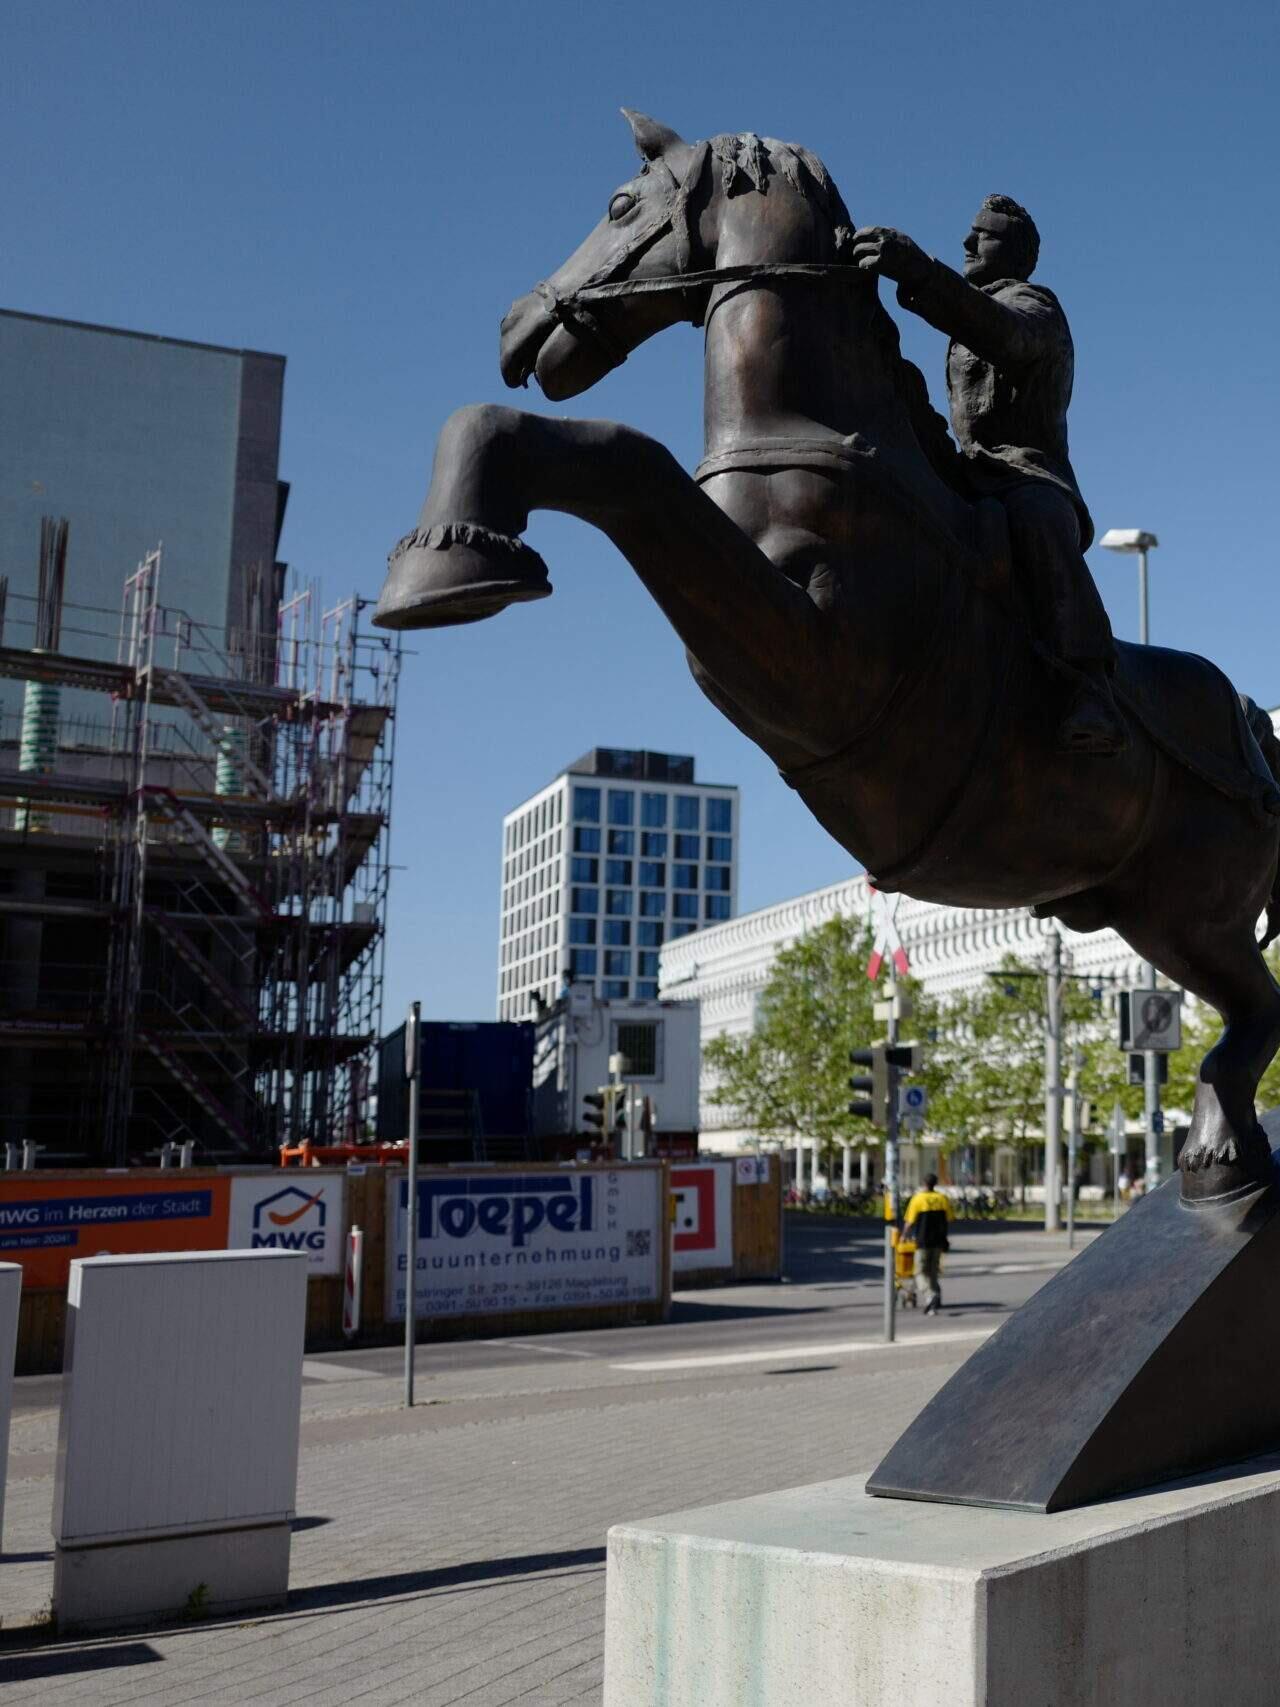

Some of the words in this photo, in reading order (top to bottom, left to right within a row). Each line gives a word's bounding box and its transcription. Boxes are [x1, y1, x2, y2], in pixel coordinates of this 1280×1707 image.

[44, 1207, 64, 1222] im
[68, 1204, 128, 1221] Herzen
[131, 1200, 157, 1217] der
[162, 1198, 201, 1214] Stadt
[399, 1175, 593, 1248] Toepel
[251, 1231, 326, 1251] MWG
[396, 1245, 622, 1272] Bauunternehmung
